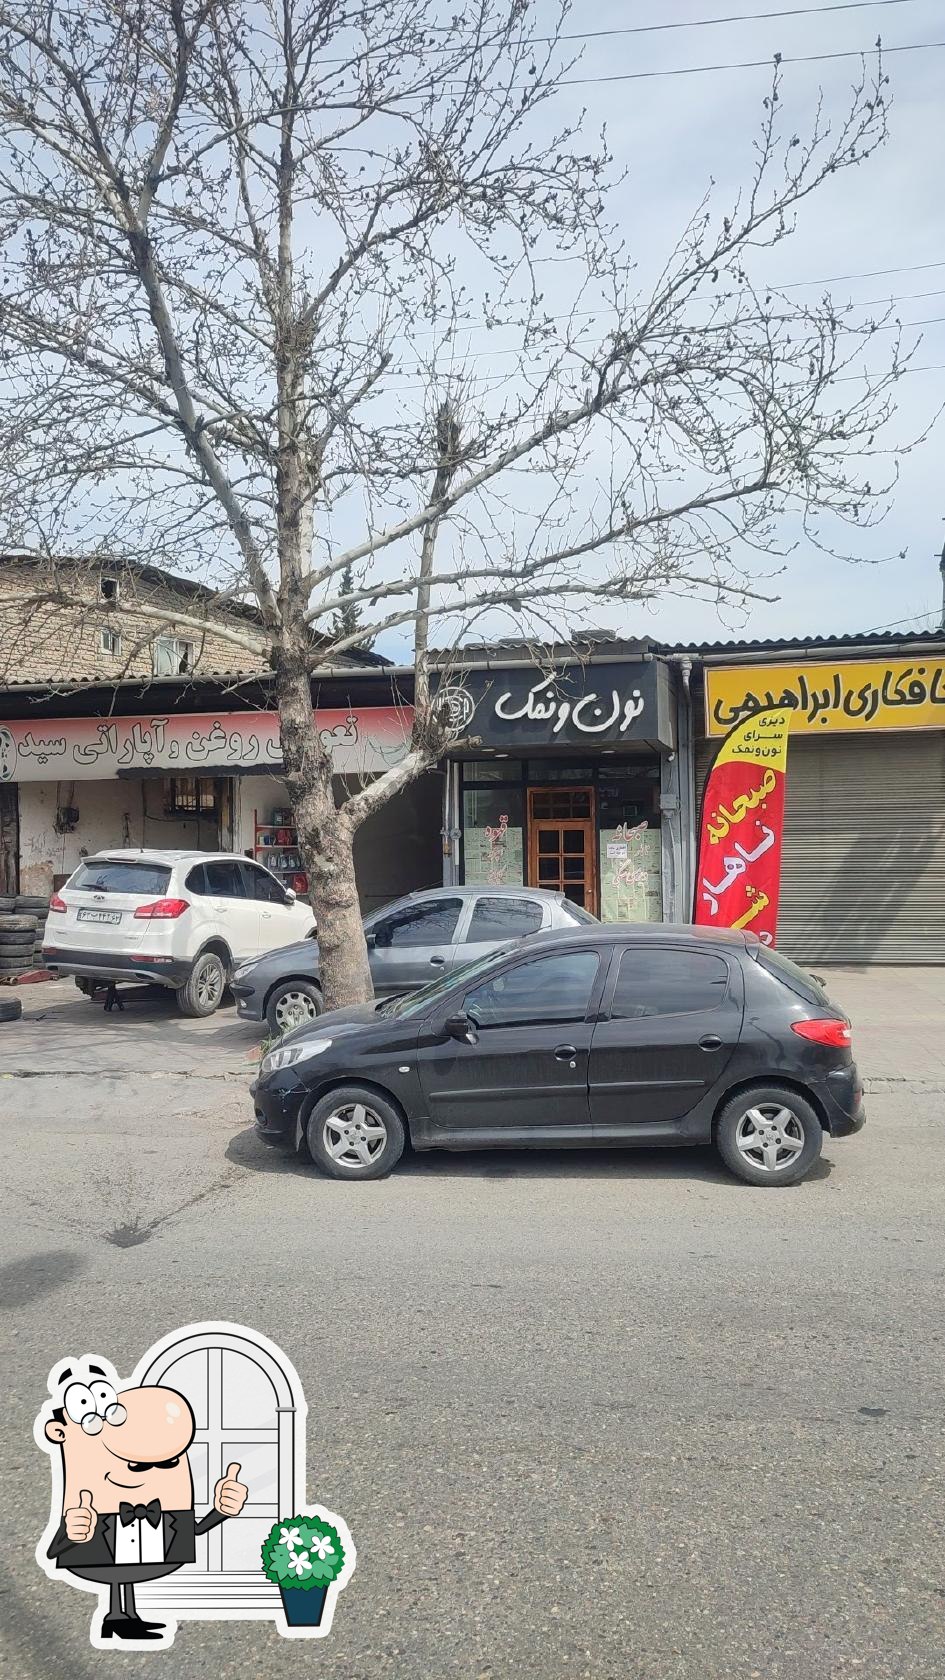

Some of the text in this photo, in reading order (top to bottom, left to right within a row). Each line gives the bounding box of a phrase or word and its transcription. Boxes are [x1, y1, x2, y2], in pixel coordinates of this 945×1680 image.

[843, 667, 945, 722] افکاری
[743, 729, 783, 741] سرای
[758, 716, 786, 727] دیزی
[18, 732, 66, 764] سید
[168, 740, 179, 759] و
[186, 721, 260, 761] روغن
[706, 769, 777, 846] صبحانه
[702, 820, 776, 916] ناهار
